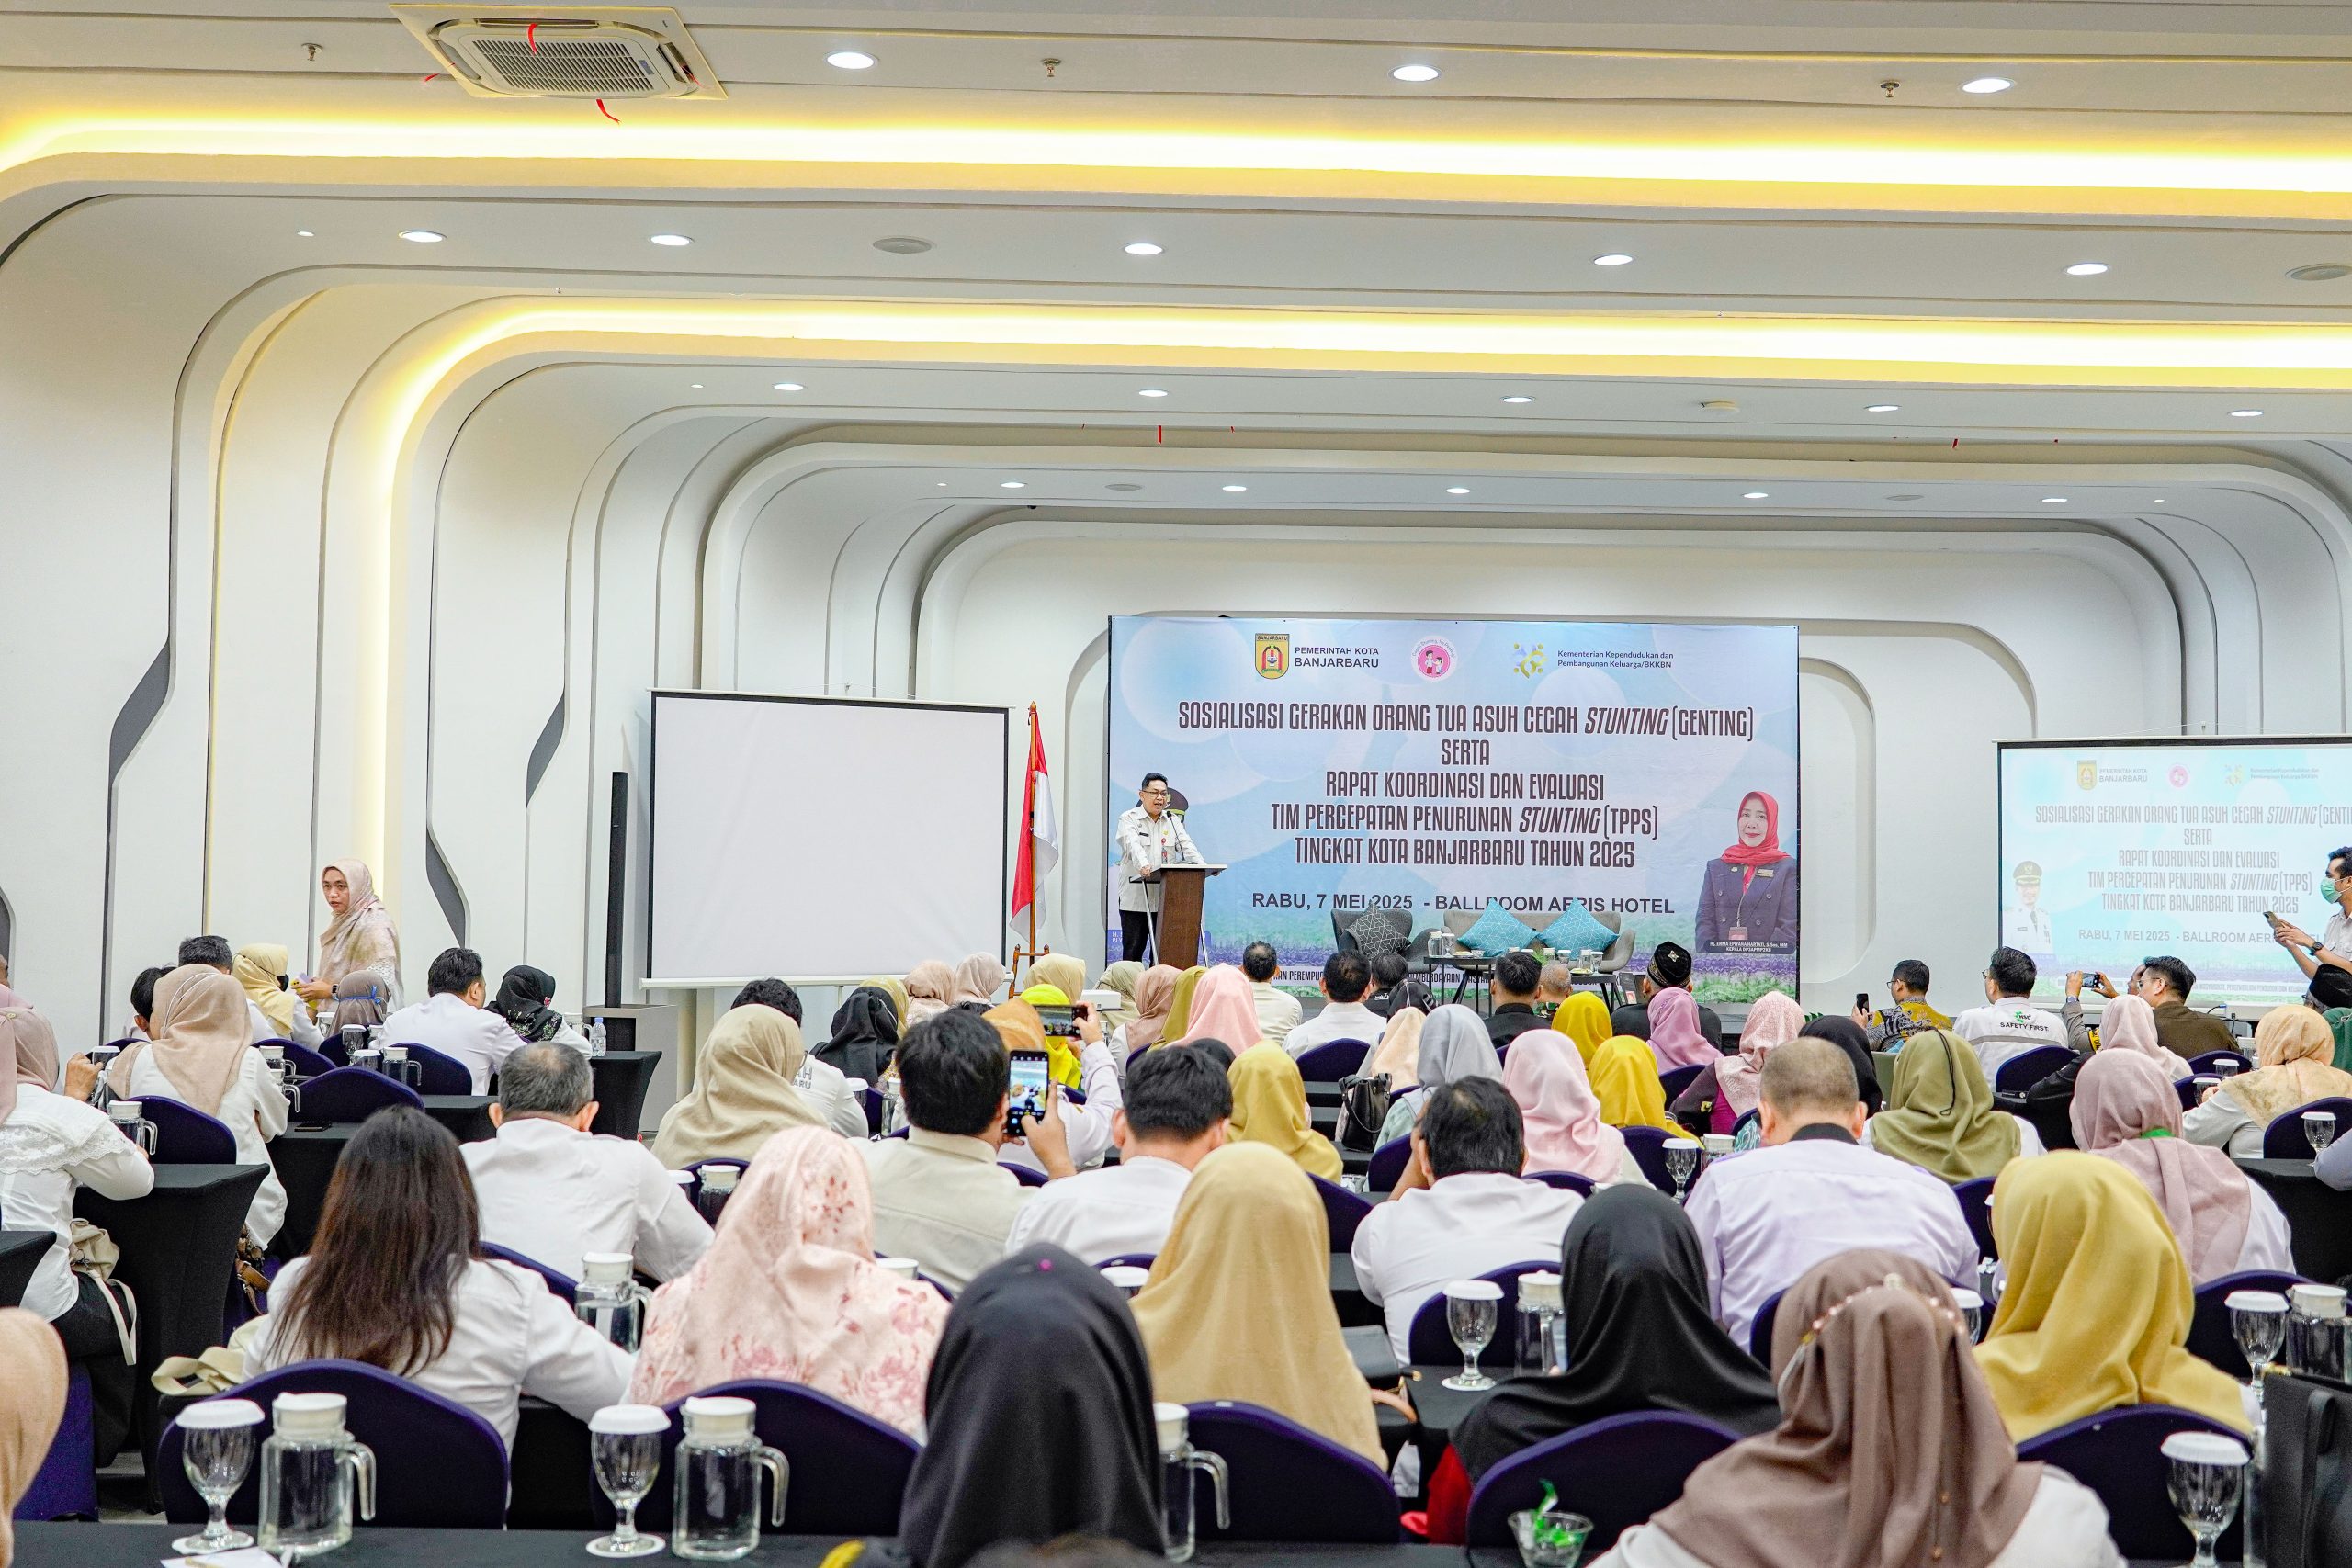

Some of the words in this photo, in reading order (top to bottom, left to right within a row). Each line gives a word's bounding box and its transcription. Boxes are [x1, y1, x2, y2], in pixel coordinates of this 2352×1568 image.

[1295, 647, 1351, 655] PEMERINTAH
[1354, 647, 1378, 655] KOTA
[1605, 651, 1658, 660] Kependudukan
[1295, 658, 1378, 668] BANJARBARU
[1610, 660, 1671, 669] Keluarga/BKKBN
[1179, 702, 1283, 729] SOSIALISASI
[1289, 704, 1366, 731] GERAKAN
[1373, 705, 1430, 732] ORANG
[1436, 705, 1466, 732] TUA
[1473, 705, 1518, 733] ASUH
[1524, 706, 1577, 733] CEGAH
[1585, 707, 1669, 735] STUNTING
[1672, 705, 1753, 741] (GENTING)
[1442, 739, 1490, 765] SERTA
[1327, 772, 1378, 796] RAPAT
[1384, 772, 1484, 798] KOORDINASI
[1490, 773, 1523, 799] DAN
[1530, 774, 1604, 800] EVALUASI
[1272, 804, 1299, 829] TIM
[1306, 804, 1408, 830] PERCEPATAN
[1414, 806, 1511, 832] PENURUNAN
[1519, 807, 1600, 834] STUNTING
[1604, 805, 1657, 840] (TPPS)
[2036, 806, 2094, 823] SOSIALISASI
[2098, 806, 2141, 823] GERAKAN
[2144, 806, 2177, 823] ORANG
[2181, 806, 2199, 823] TUA
[2201, 806, 2228, 823] ASUH
[2232, 806, 2263, 824] CEGAH
[2267, 806, 2317, 824] STUNTING
[2184, 829, 2212, 845] SERTA
[1295, 838, 1363, 863] TINGKAT
[1368, 838, 1408, 864] KOTA
[1414, 839, 1525, 865] BANJARBARU
[1531, 840, 1584, 867] TAHUN
[1590, 841, 1634, 868] 2025
[2119, 850, 2149, 867] RAPAT
[2152, 850, 2210, 867] KOORDINASI
[2212, 851, 2232, 867] DAN
[2236, 851, 2279, 868] EVALUASI
[2088, 871, 2104, 888] TIM
[2108, 872, 2165, 888] PERCEPATAN
[2169, 873, 2225, 889] PENURUNAN
[2231, 873, 2278, 890] STUNTING
[2280, 871, 2312, 896] (TPPS)
[1252, 893, 1310, 910] RABU,
[1317, 894, 1327, 908] 7
[1333, 894, 1365, 908] MEI
[1372, 895, 1412, 909] 2025
[1611, 898, 1675, 913] HOTEL
[2102, 893, 2141, 910] TINGKAT
[2143, 894, 2166, 911] KOTA
[2170, 895, 2233, 912] BANJARBARU
[2237, 896, 2268, 913] TAHUN
[2272, 896, 2299, 913] 2025
[2078, 930, 2112, 941] RABU,
[2115, 931, 2120, 940] 7
[2124, 931, 2143, 941] MEI
[2146, 931, 2170, 941] 2025
[2183, 931, 2245, 942] BALLROOM
[2249, 933, 2275, 943] AER
